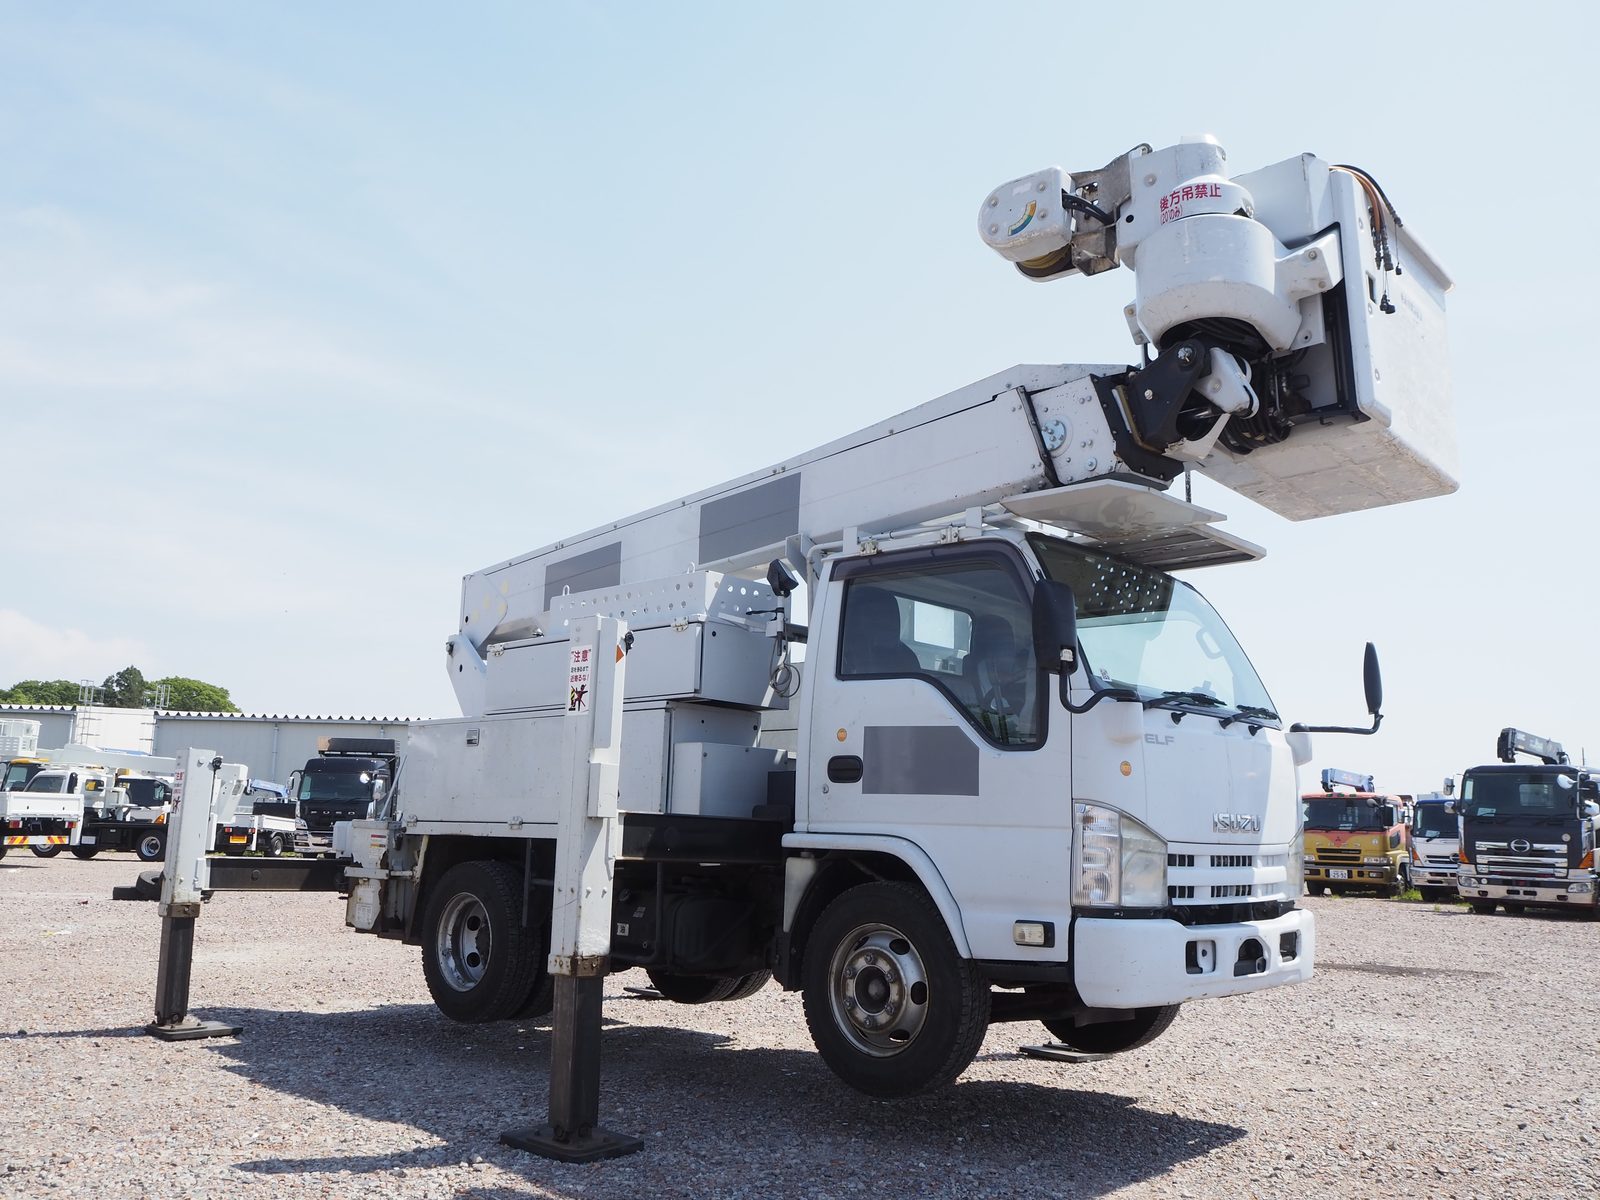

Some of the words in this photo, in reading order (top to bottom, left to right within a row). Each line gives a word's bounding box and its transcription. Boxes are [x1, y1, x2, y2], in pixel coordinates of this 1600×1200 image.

[1160, 183, 1222, 212] 後方吊禁止
[1144, 733, 1175, 746] ELF
[1212, 811, 1261, 834] ISUZU
